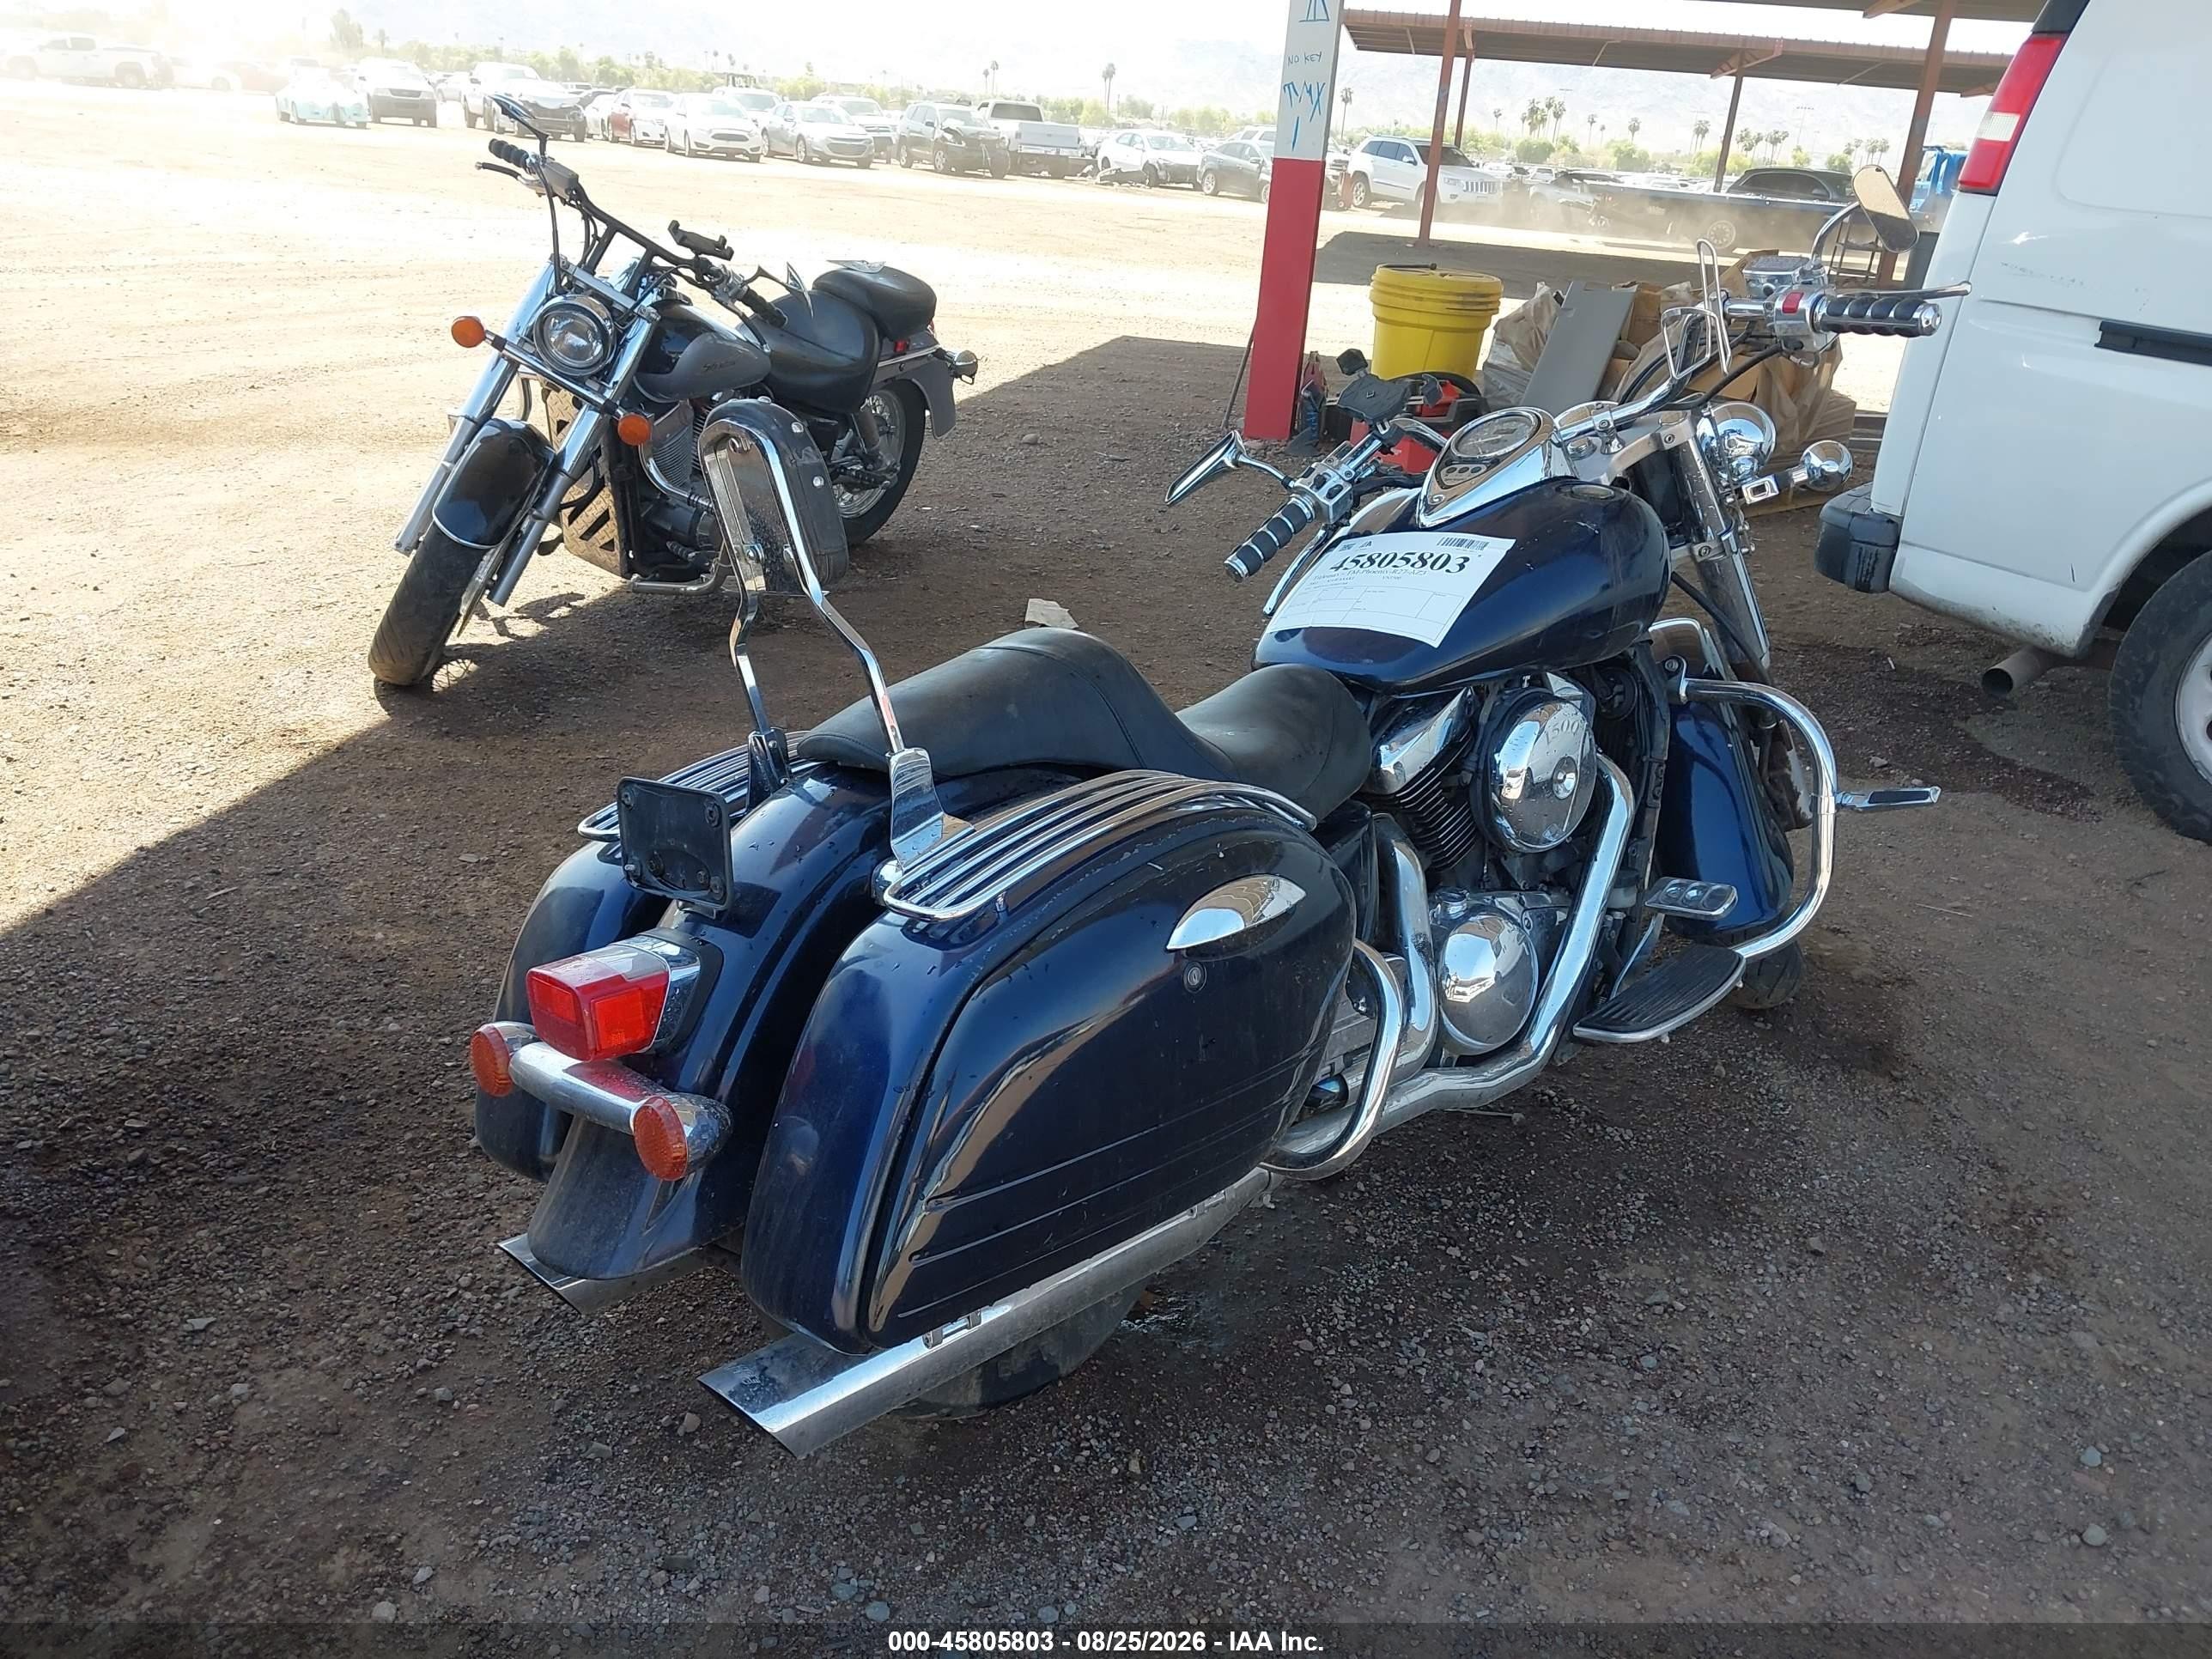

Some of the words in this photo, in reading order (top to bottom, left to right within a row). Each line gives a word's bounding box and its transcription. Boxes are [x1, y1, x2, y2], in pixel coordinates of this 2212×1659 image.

[1288, 55, 1300, 64] NO
[1304, 51, 1322, 64] KEY
[1330, 550, 1471, 574] 45805803
